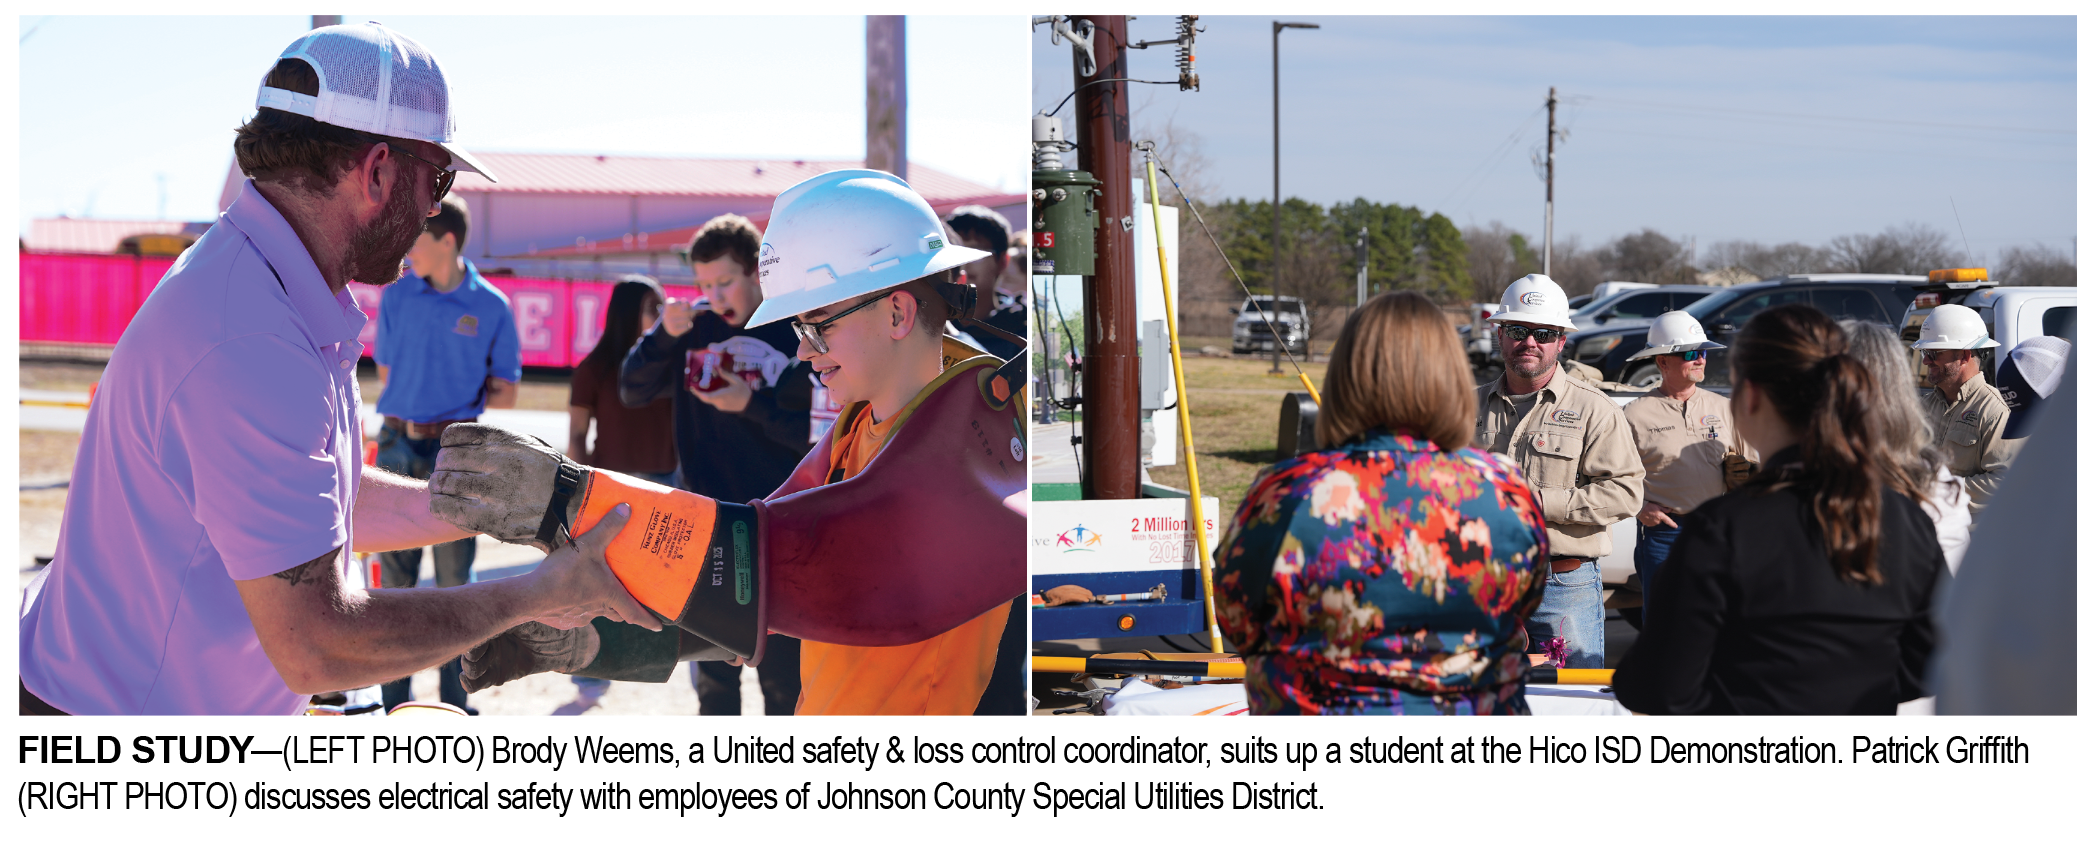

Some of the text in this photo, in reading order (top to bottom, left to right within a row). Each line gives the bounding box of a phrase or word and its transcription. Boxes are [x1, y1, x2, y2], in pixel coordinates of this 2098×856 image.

[1647, 425, 1676, 434] Thomas
[1131, 518, 1140, 532] 2
[1144, 517, 1188, 531] Million
[1149, 539, 1196, 563] 2017
[712, 573, 723, 586] OCT
